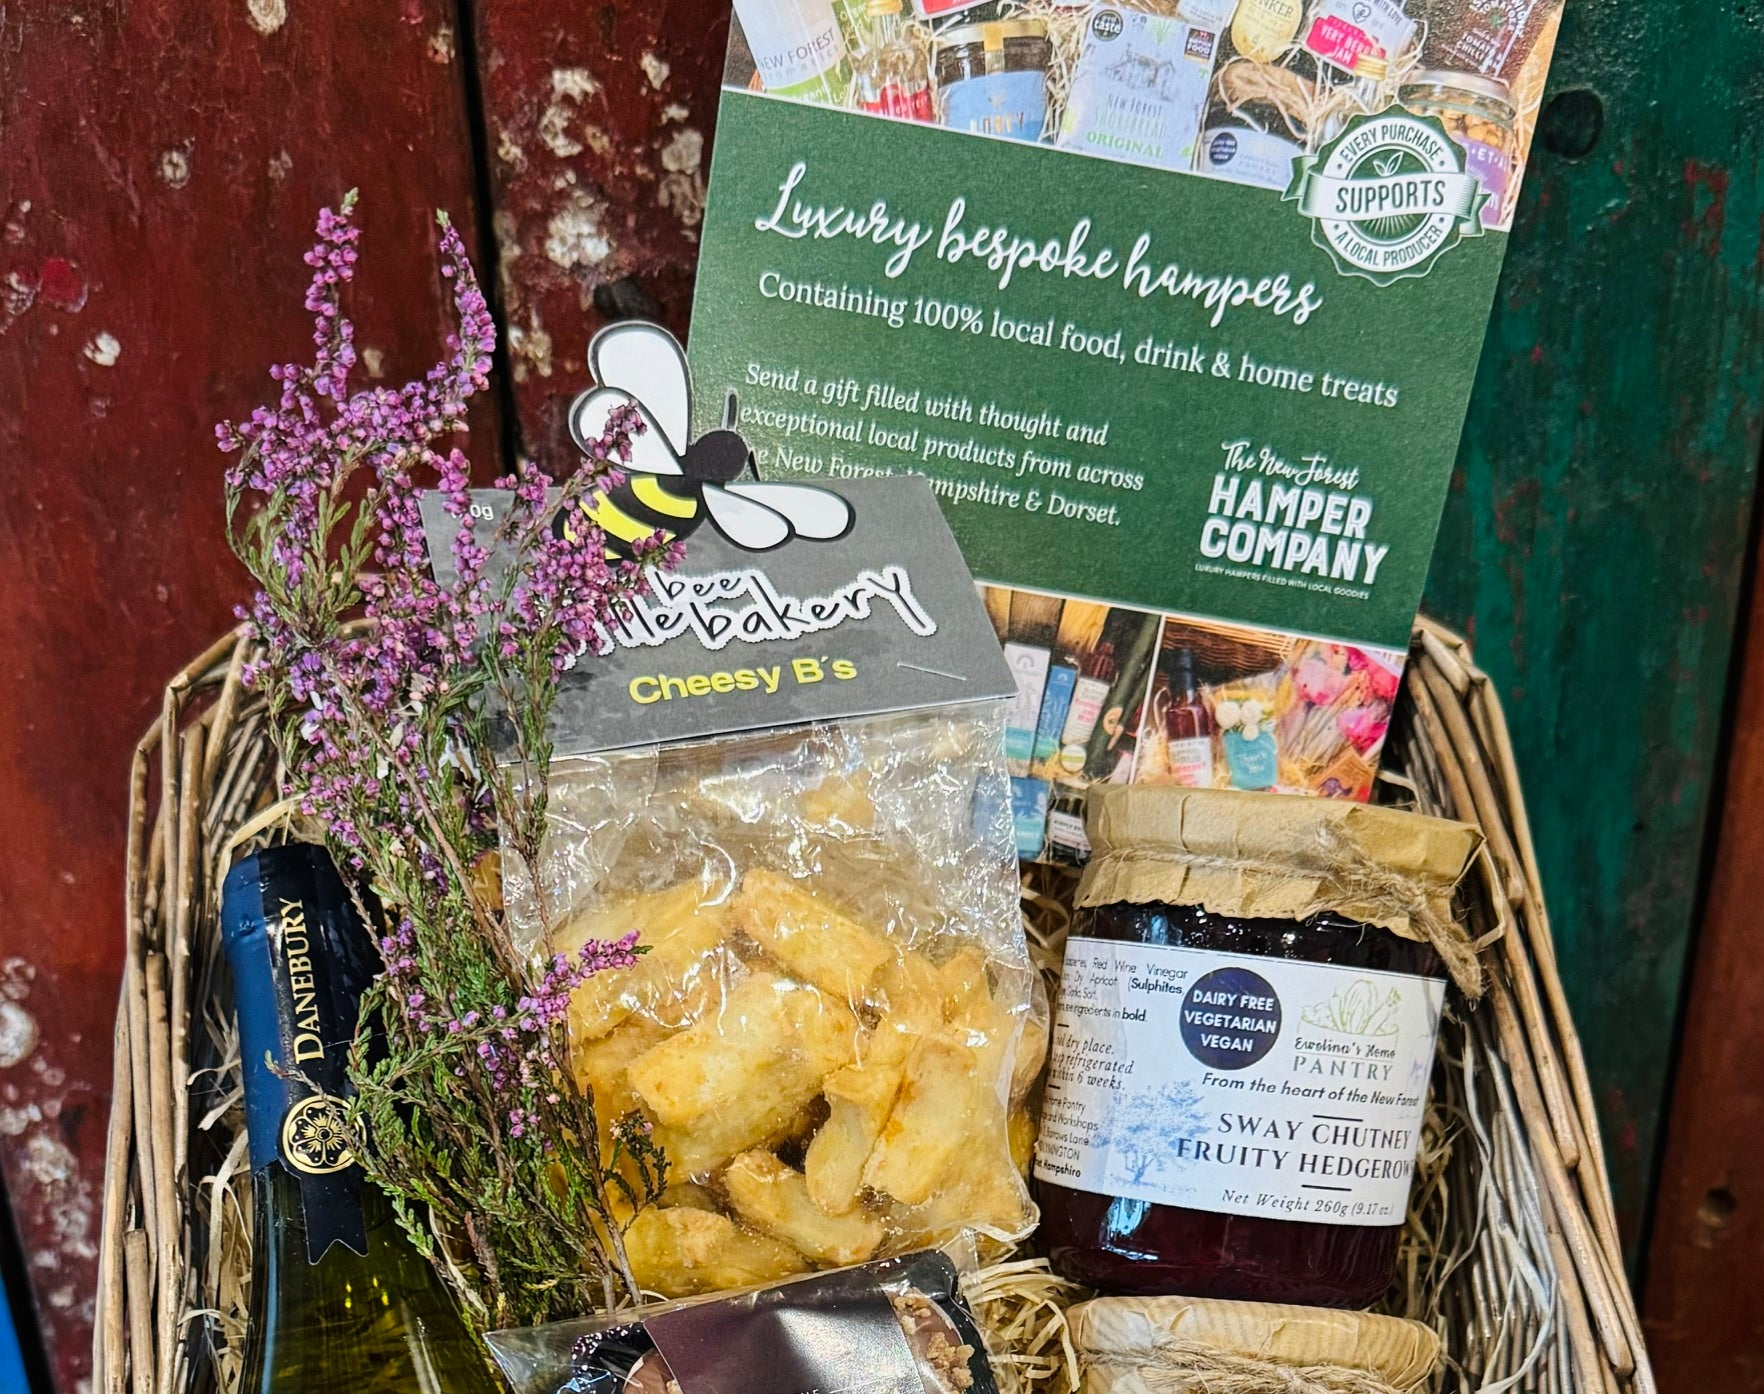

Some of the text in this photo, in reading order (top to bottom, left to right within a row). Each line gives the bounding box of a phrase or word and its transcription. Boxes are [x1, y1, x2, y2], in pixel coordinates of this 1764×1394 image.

[1332, 44, 1351, 65] JAM
[1086, 131, 1164, 158] ORIGINAL
[1340, 128, 1378, 162] EVERY
[1381, 124, 1445, 161] PURCHASE
[1335, 180, 1447, 214] SUPPORTS
[755, 162, 1324, 328] Luxury bespoke hampers
[1335, 224, 1444, 267] A LOCAL PRODUCER
[758, 271, 1398, 408] Containing 100% local food, drink & home treats
[745, 363, 1110, 447] Send a gift filled with thought and
[740, 406, 1145, 491] exceptional local products from across
[1221, 441, 1361, 491] The New Forest
[775, 447, 824, 474] New
[1024, 488, 1043, 513] &
[1046, 492, 1122, 526] Dorset.
[1207, 473, 1373, 540] HAMPER
[1199, 519, 1390, 586] COMPANY
[653, 571, 742, 601] bee
[1194, 563, 1370, 600] LUXURY HAMPERS FILLED WITH LOCAL GOODIES
[690, 571, 930, 643] bakery
[628, 665, 783, 705] Cheesy
[278, 897, 326, 1066] DANEBURY
[1146, 963, 1189, 981] Vinegar
[1192, 989, 1275, 1013] DAIRY FREE
[1183, 1009, 1278, 1035] VEGETARIAN
[1081, 1038, 1116, 1056] place.
[1200, 1032, 1254, 1053] VEGAN
[1065, 1052, 1135, 1075] refrigerated
[1292, 1055, 1394, 1082] PANTRY
[1086, 1074, 1126, 1091] weeks.
[1201, 1071, 1246, 1091] From
[1249, 1077, 1277, 1093] the
[1281, 1080, 1327, 1100] heart
[1327, 1085, 1346, 1102] of
[1346, 1086, 1369, 1104] the
[1370, 1090, 1397, 1106] New
[1217, 1112, 1413, 1151] SWAY CHUTNEY
[1177, 1137, 1291, 1171] FRUITY
[1221, 1188, 1250, 1205] Net
[1256, 1192, 1310, 1213] Weight
[1313, 1199, 1349, 1218] 260g
[1350, 1201, 1378, 1217] (9.17
